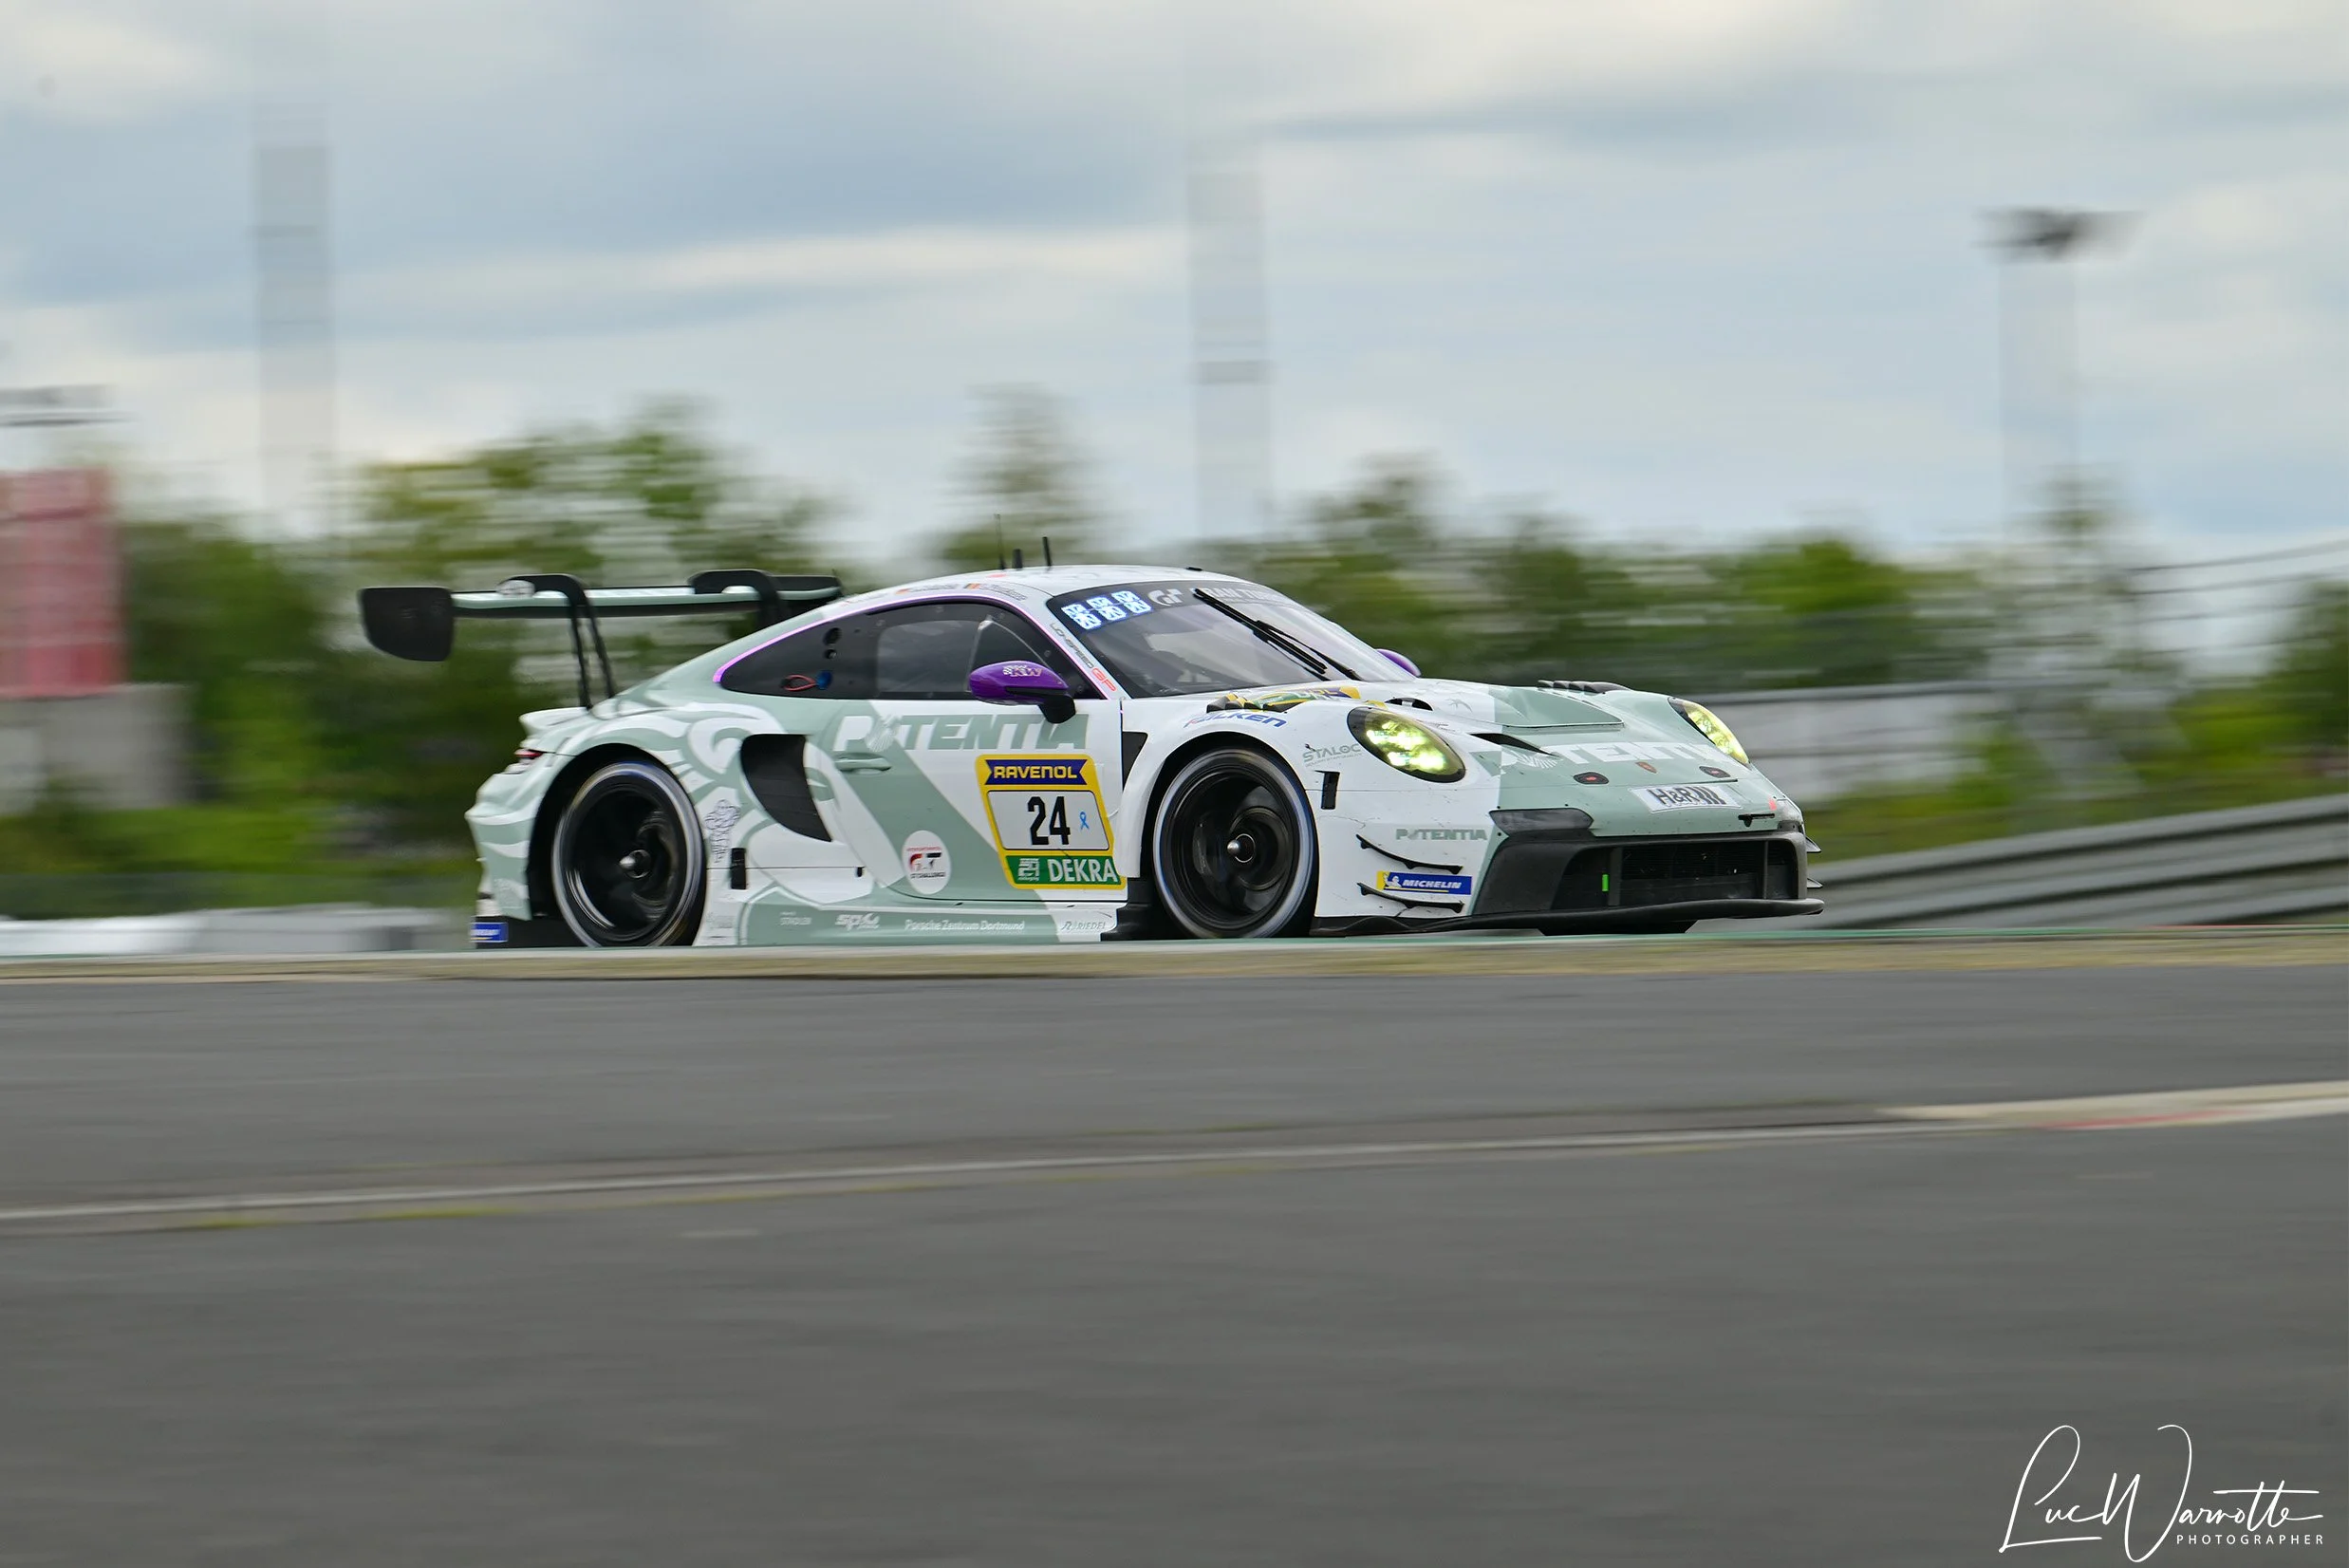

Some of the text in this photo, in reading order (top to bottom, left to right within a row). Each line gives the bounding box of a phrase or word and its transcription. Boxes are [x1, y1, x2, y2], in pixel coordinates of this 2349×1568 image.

[1091, 667, 1117, 692] GP
[1302, 742, 1362, 763] STALOC
[994, 765, 1078, 779] RAVENOL
[1647, 787, 1701, 804] H&R
[1027, 795, 1071, 845] 24
[1047, 858, 1119, 883] DEKRA
[1402, 879, 1463, 889] MICHELIN
[904, 919, 1025, 931] Porsche Zentrum Dortmund
